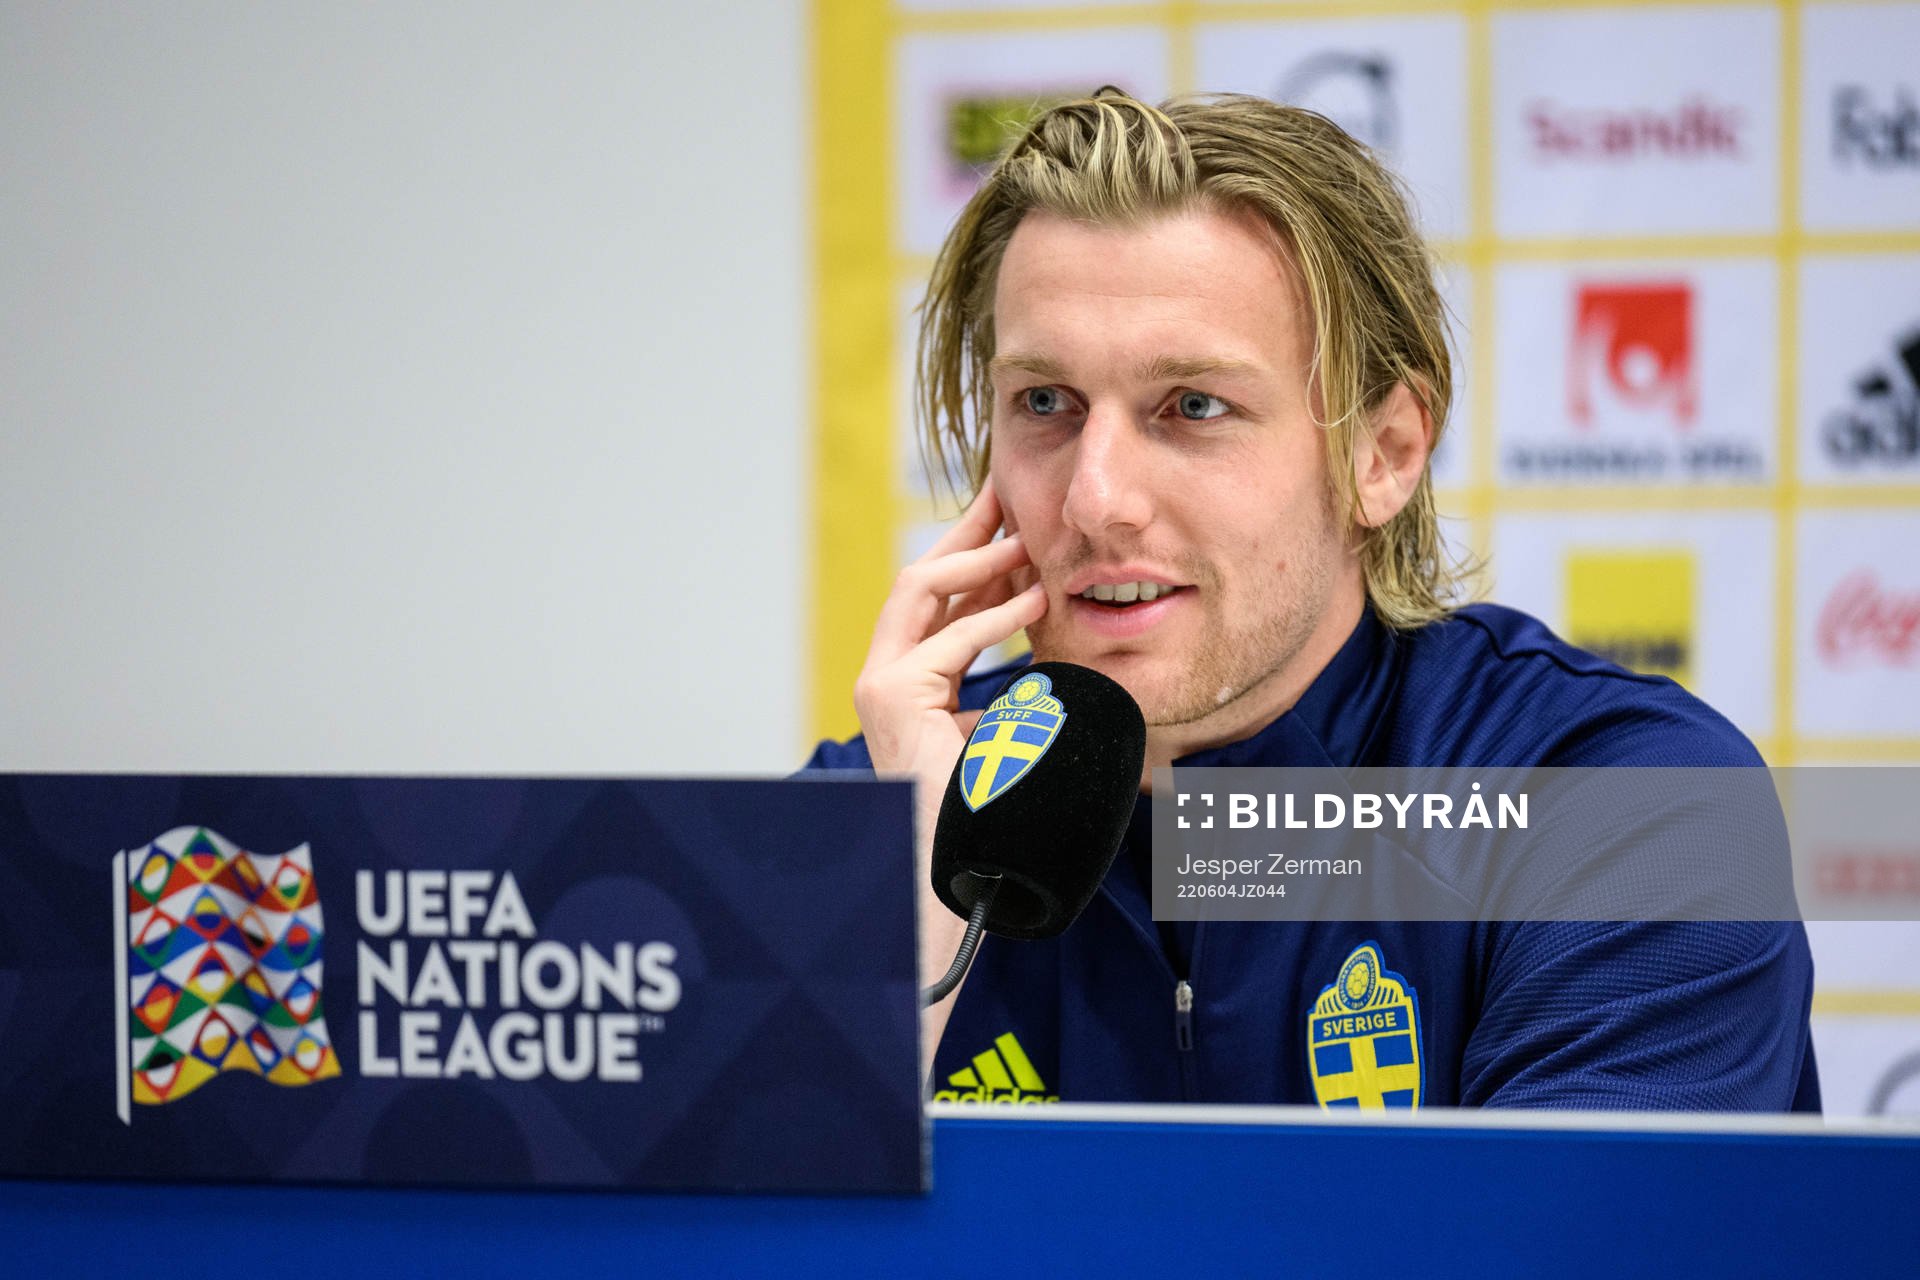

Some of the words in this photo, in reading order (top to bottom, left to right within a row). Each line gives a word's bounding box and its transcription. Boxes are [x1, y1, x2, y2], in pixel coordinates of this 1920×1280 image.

[996, 710, 1032, 721] SvFF
[356, 870, 535, 937] UEFA
[357, 940, 682, 1011] NATIONS
[359, 1011, 643, 1081] LEAGUE
[1322, 1011, 1397, 1037] SVERIGE
